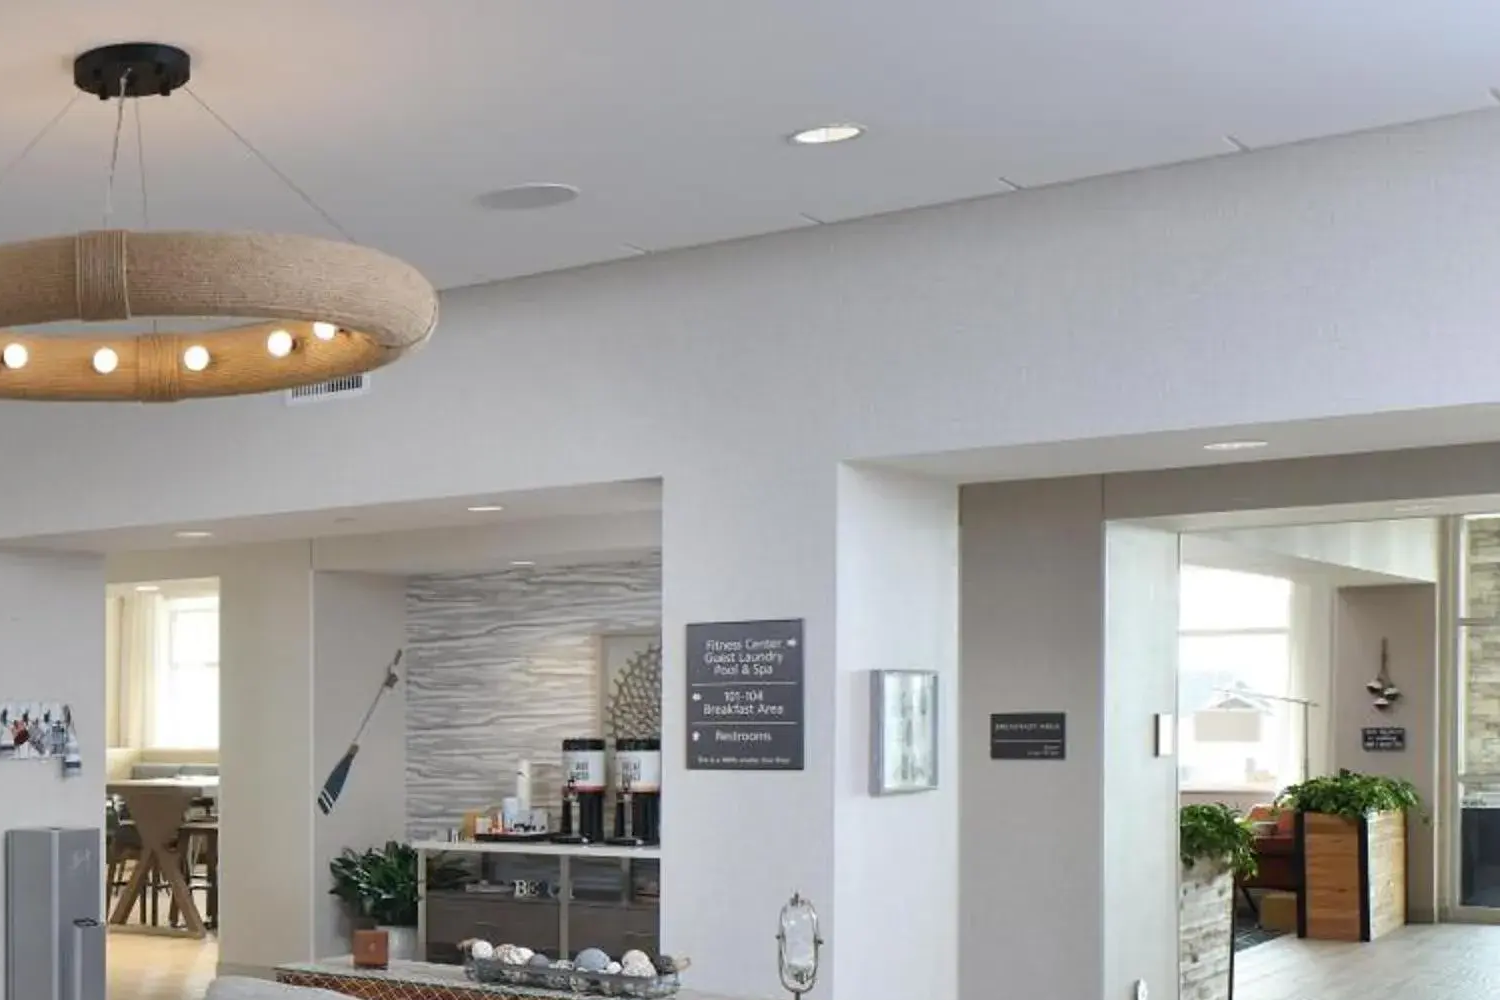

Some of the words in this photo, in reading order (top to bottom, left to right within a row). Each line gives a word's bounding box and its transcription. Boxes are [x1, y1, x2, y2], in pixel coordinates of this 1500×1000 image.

[705, 639, 742, 652] Fitness
[745, 638, 783, 650] Center
[704, 652, 736, 664] Guest
[739, 651, 784, 665] Laundry
[713, 664, 739, 676] Pool
[741, 664, 751, 675] &
[753, 664, 774, 677] Spa
[703, 704, 754, 716] Breakfast
[757, 703, 784, 715] Area
[715, 730, 772, 742] Restrooms
